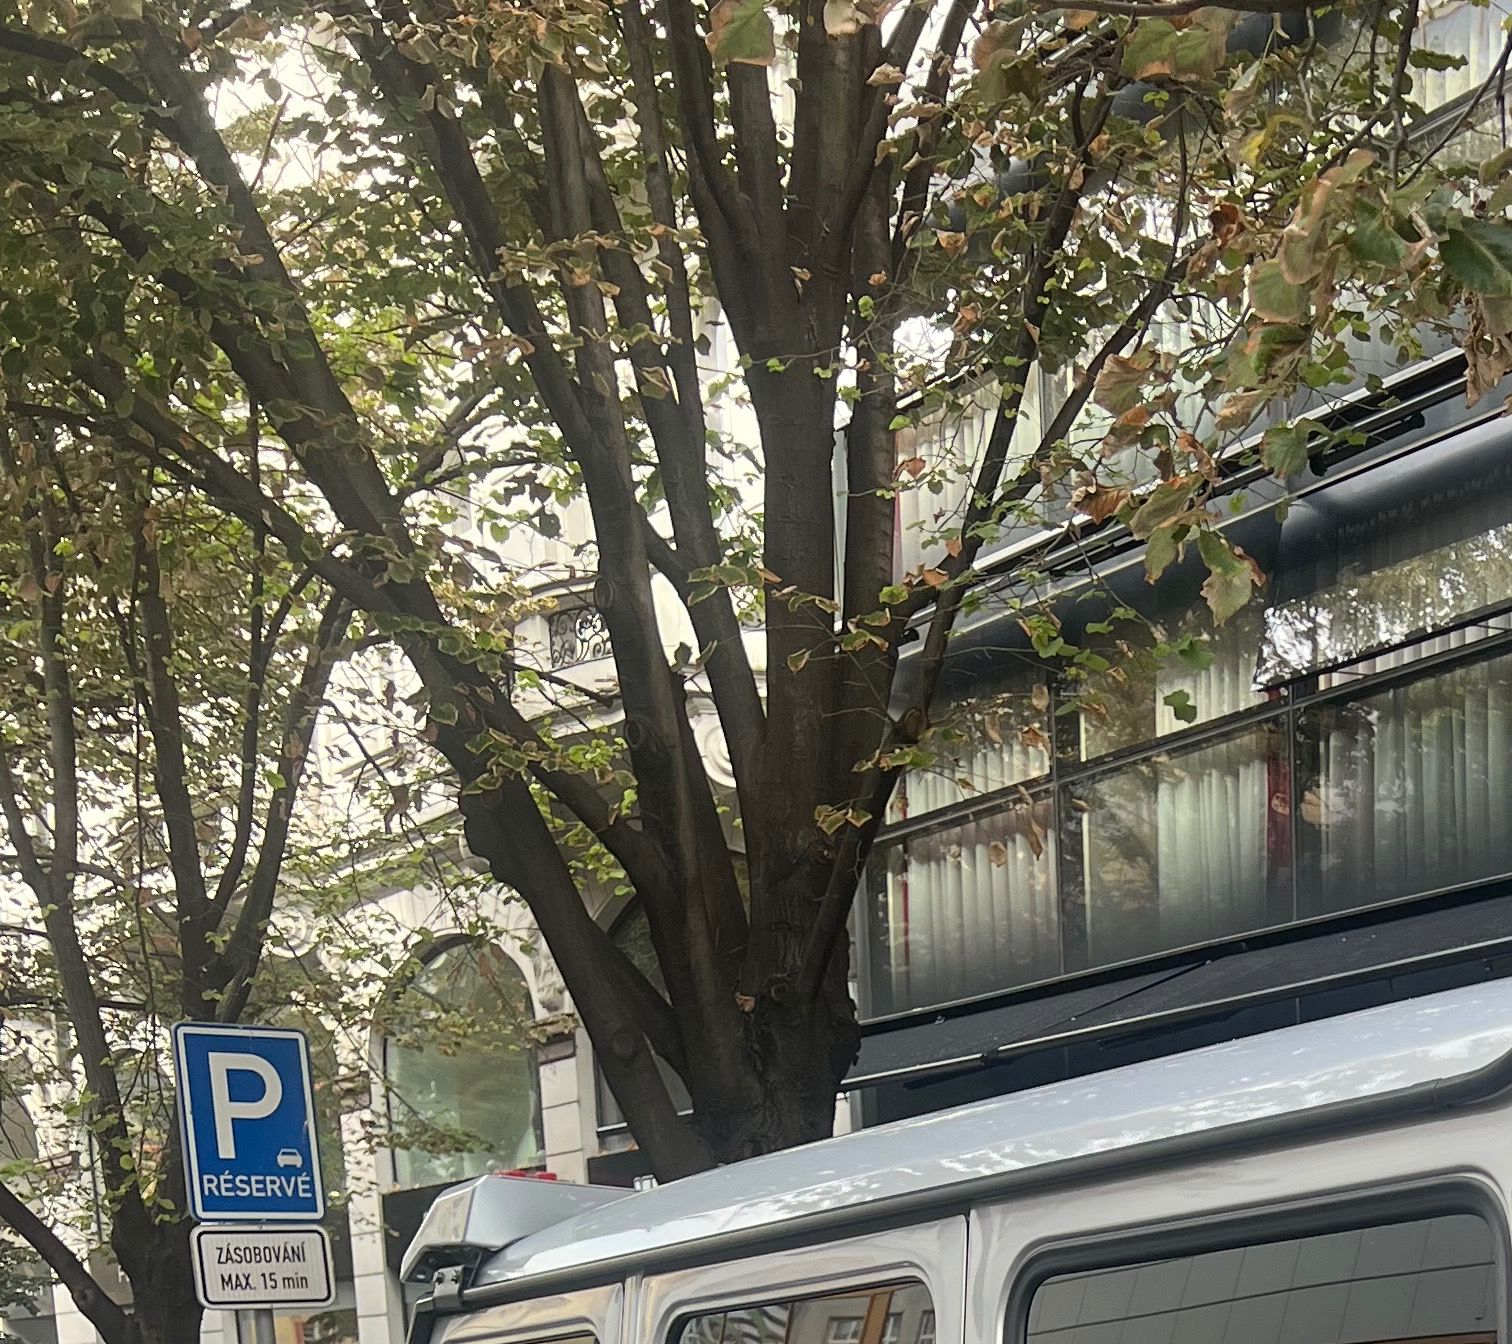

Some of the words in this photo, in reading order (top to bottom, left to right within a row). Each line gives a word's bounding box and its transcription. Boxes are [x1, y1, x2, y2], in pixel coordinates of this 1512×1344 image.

[208, 1052, 282, 1159] P
[202, 1170, 313, 1198] RÉSERVÉ
[215, 1241, 307, 1265] ZÁSOBOVÁNÍ
[220, 1273, 257, 1292] MAX.
[260, 1272, 278, 1290] 15
[282, 1272, 309, 1289] min
